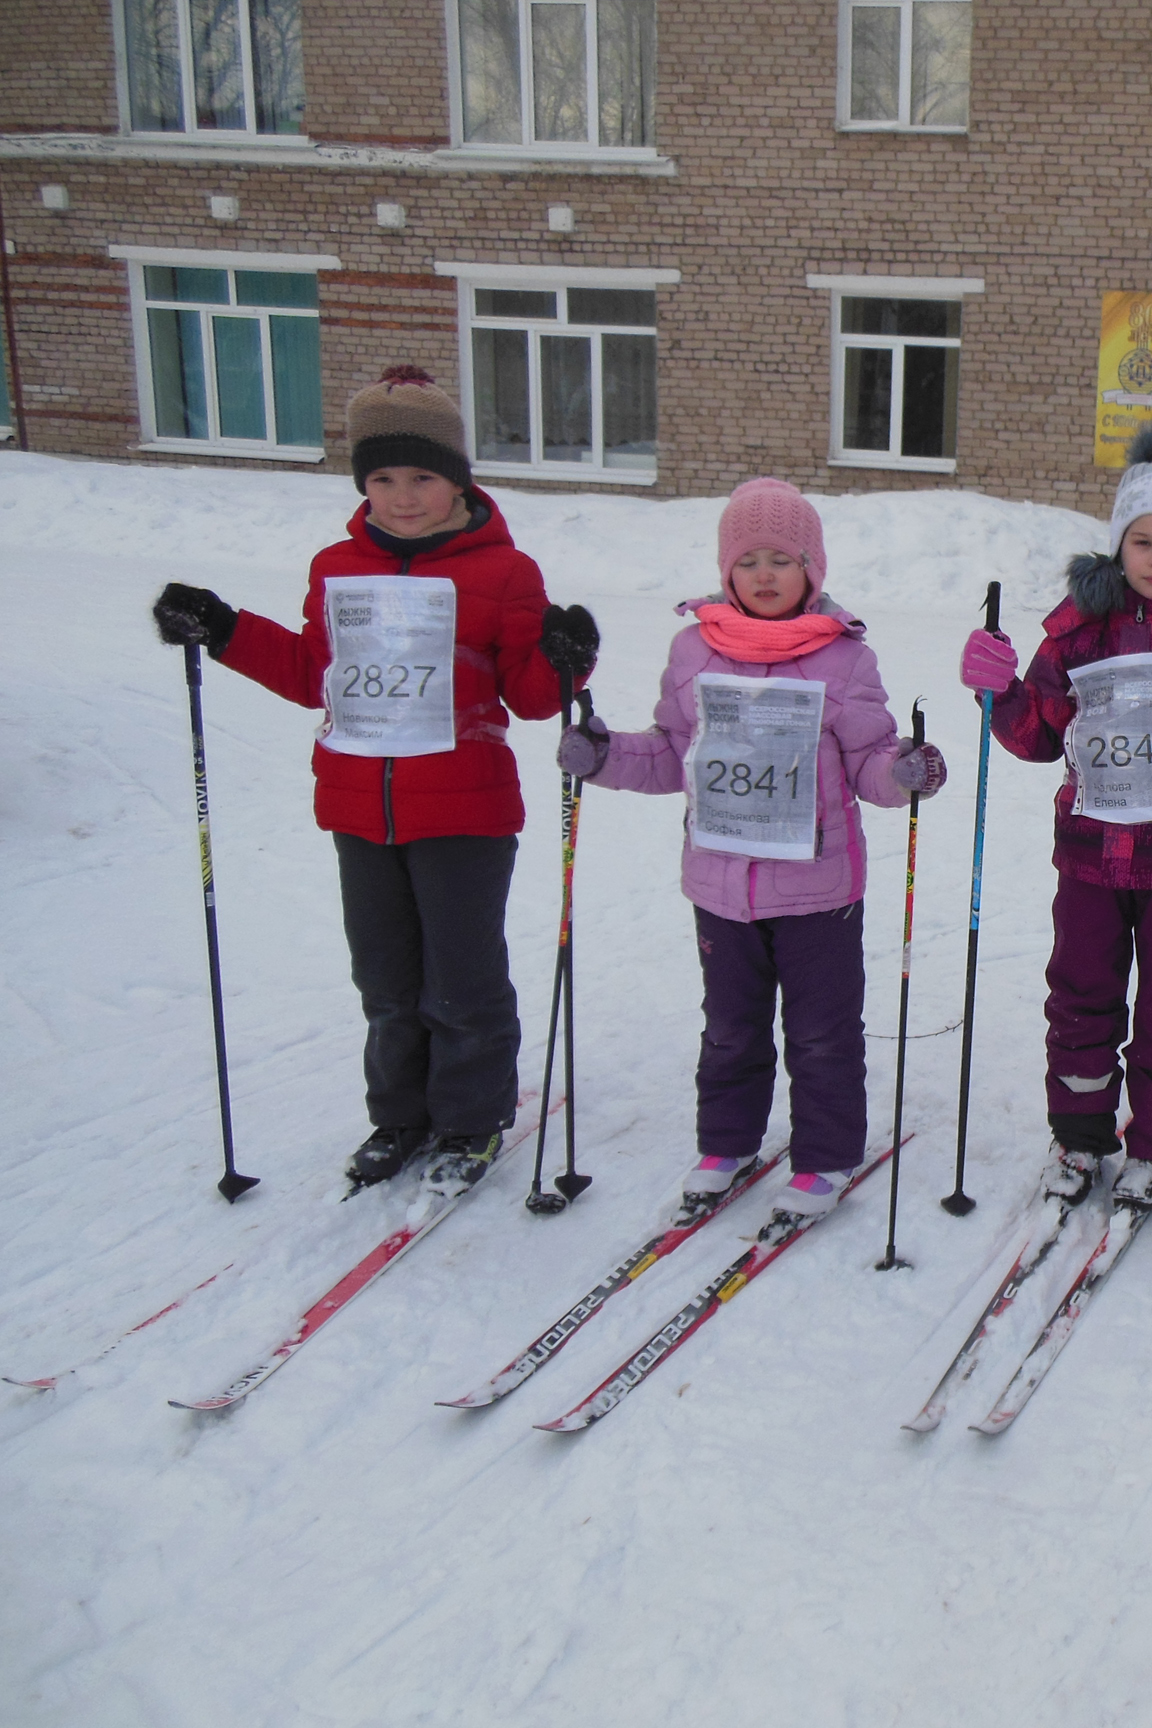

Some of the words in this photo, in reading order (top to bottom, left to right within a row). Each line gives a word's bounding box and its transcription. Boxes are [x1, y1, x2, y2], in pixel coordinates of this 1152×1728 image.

[338, 607, 372, 617] ЛЫЖНЯ
[338, 617, 372, 627] РОССИИ
[342, 664, 437, 698] 2827
[706, 760, 799, 800] 2841
[1093, 796, 1128, 808] Елена
[706, 805, 770, 824] Третьякова
[705, 820, 742, 836] Софья
